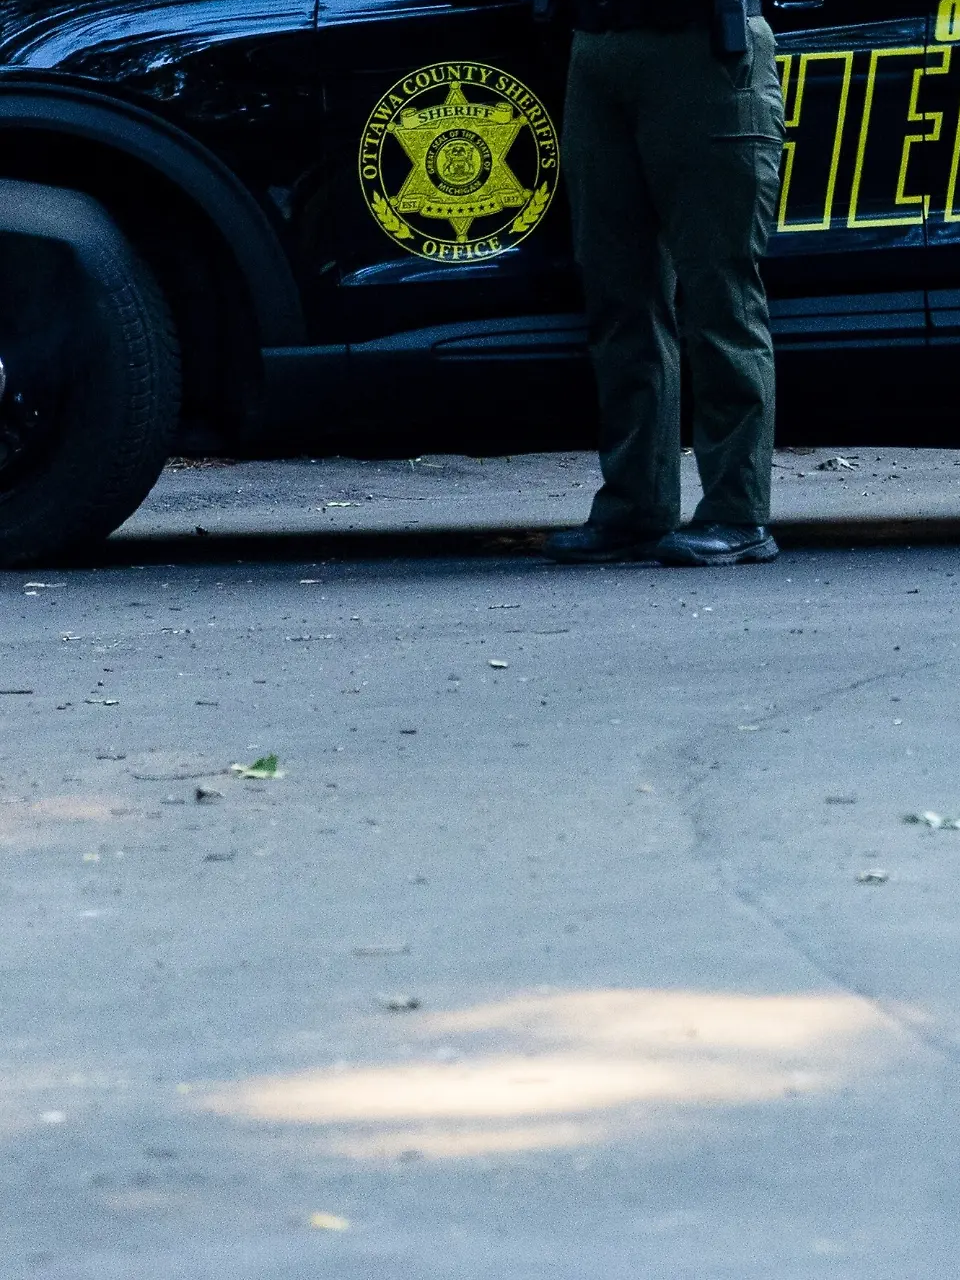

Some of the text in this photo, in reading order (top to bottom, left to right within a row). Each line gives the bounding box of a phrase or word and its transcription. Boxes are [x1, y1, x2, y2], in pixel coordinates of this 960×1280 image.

[362, 65, 557, 181] OTTAWA COUNTY SHERIFF'S
[418, 104, 494, 123] SHERIFF
[421, 236, 502, 260] OFFICE
